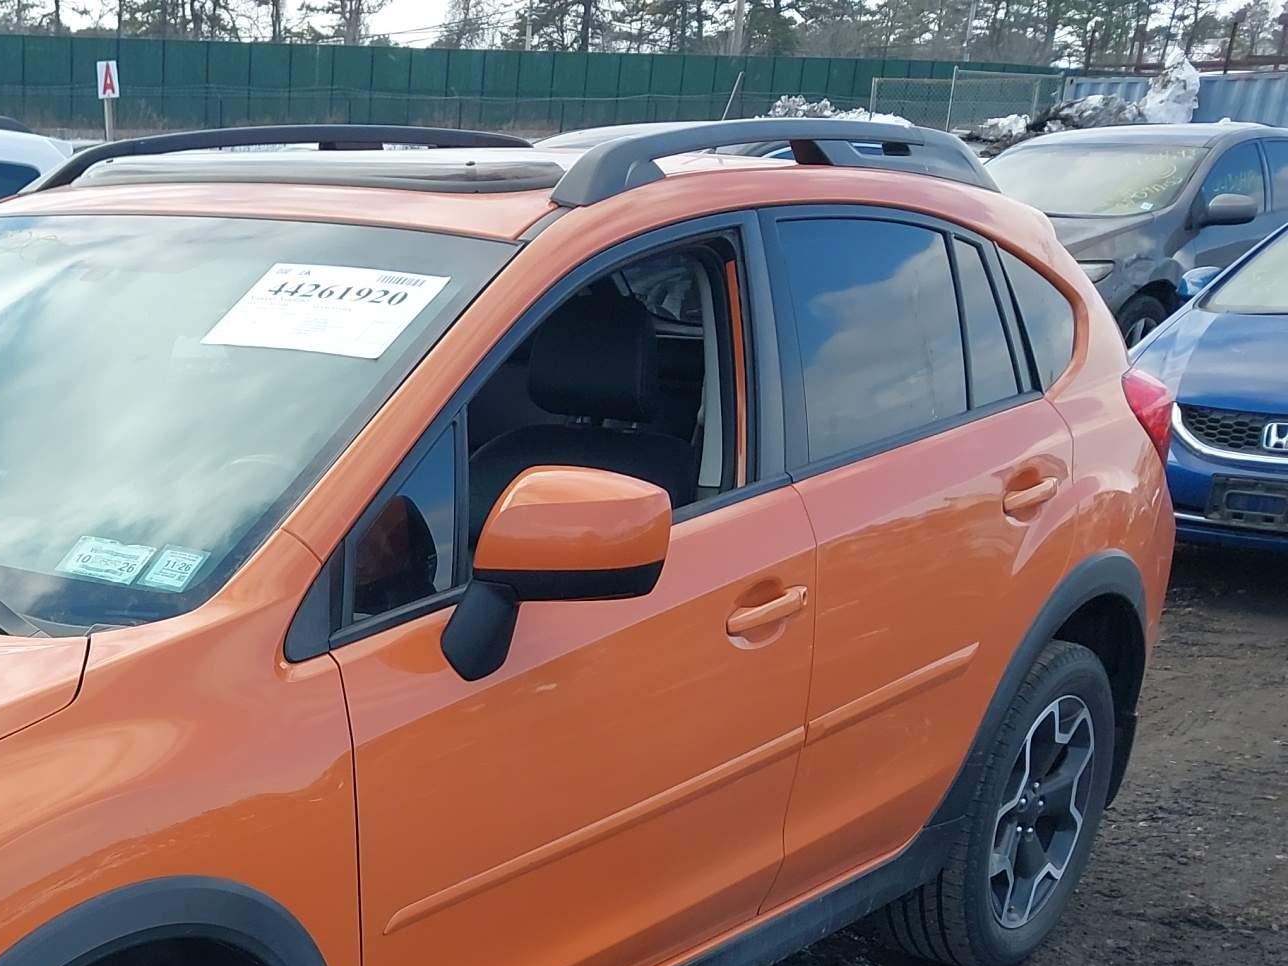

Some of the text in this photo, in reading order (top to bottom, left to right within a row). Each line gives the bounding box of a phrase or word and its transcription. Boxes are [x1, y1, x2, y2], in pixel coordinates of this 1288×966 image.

[103, 62, 115, 95] A
[268, 281, 409, 306] 44261920
[117, 562, 136, 573] 26
